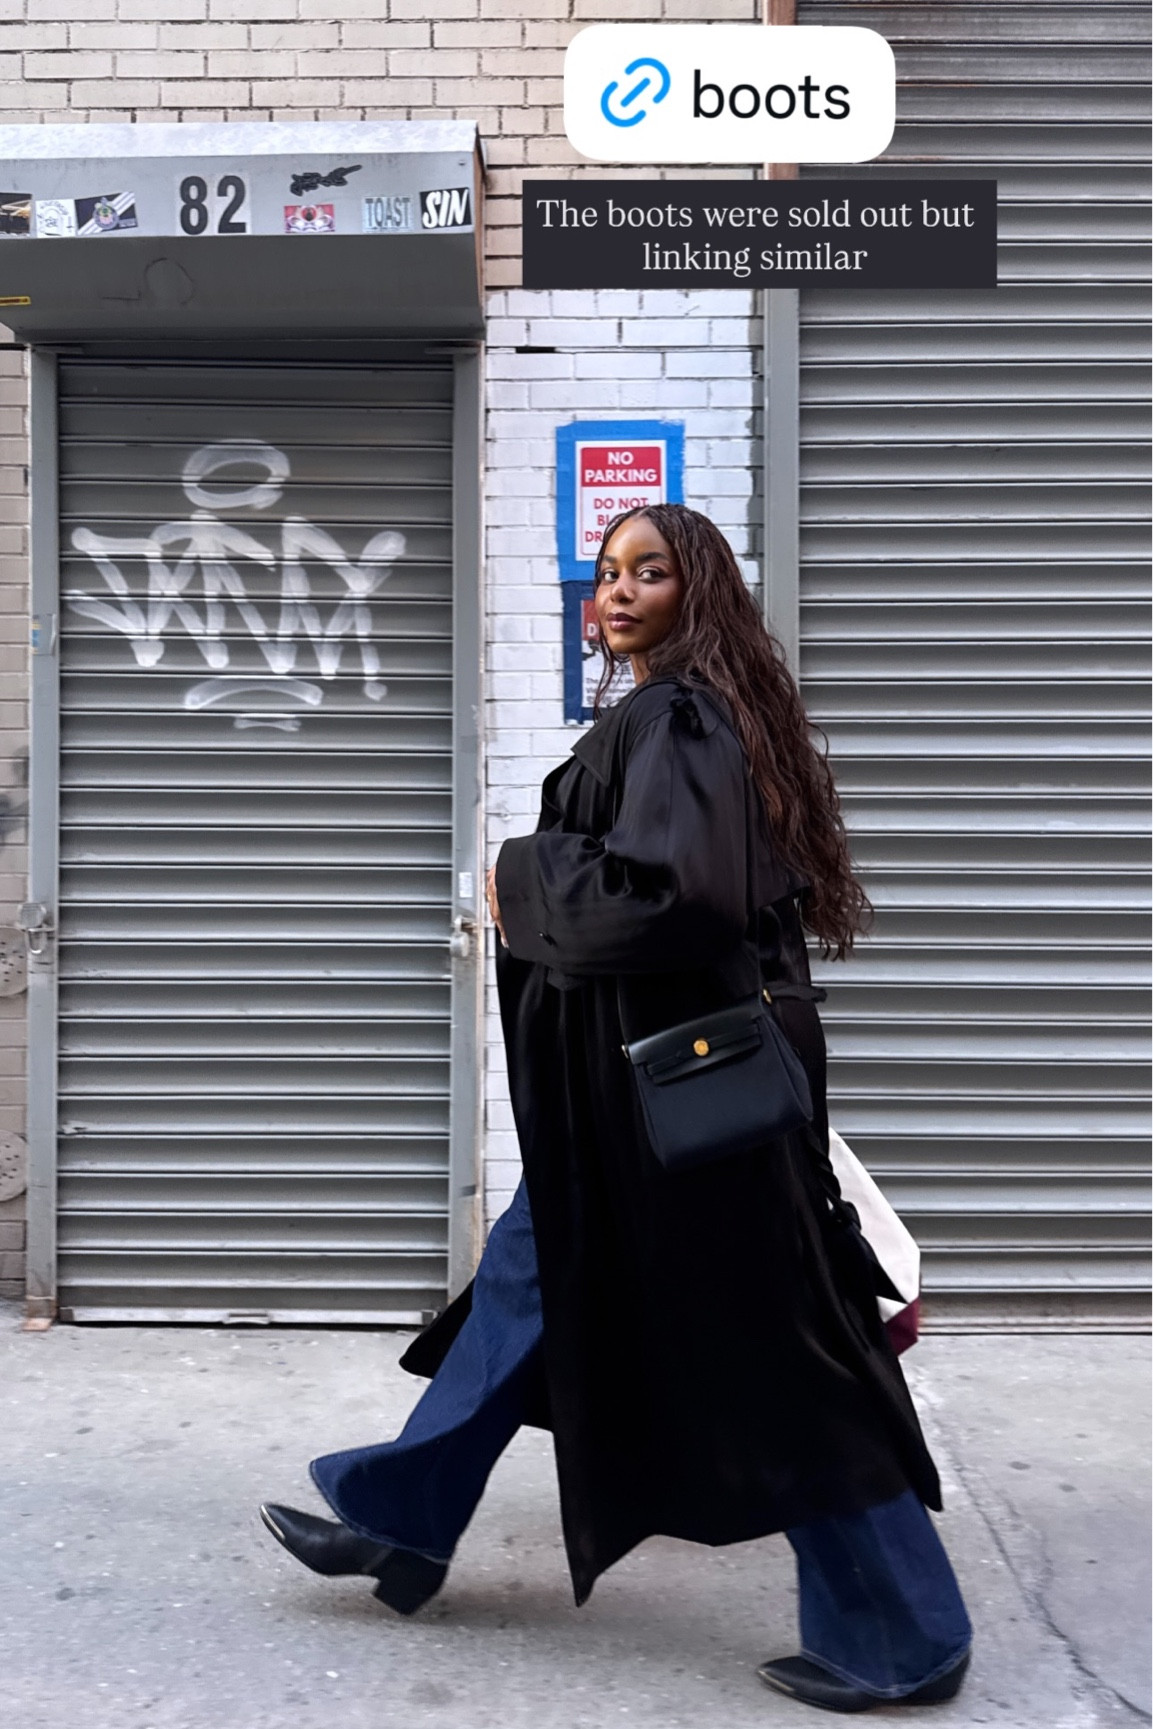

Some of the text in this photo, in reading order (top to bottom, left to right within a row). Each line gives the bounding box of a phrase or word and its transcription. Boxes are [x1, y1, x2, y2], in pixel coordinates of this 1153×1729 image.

[179, 174, 247, 236] 82
[364, 197, 411, 228] TOAST
[422, 189, 469, 229] SIN
[608, 452, 634, 465] NO
[585, 469, 657, 482] PARKING
[594, 498, 648, 510] DO NOT
